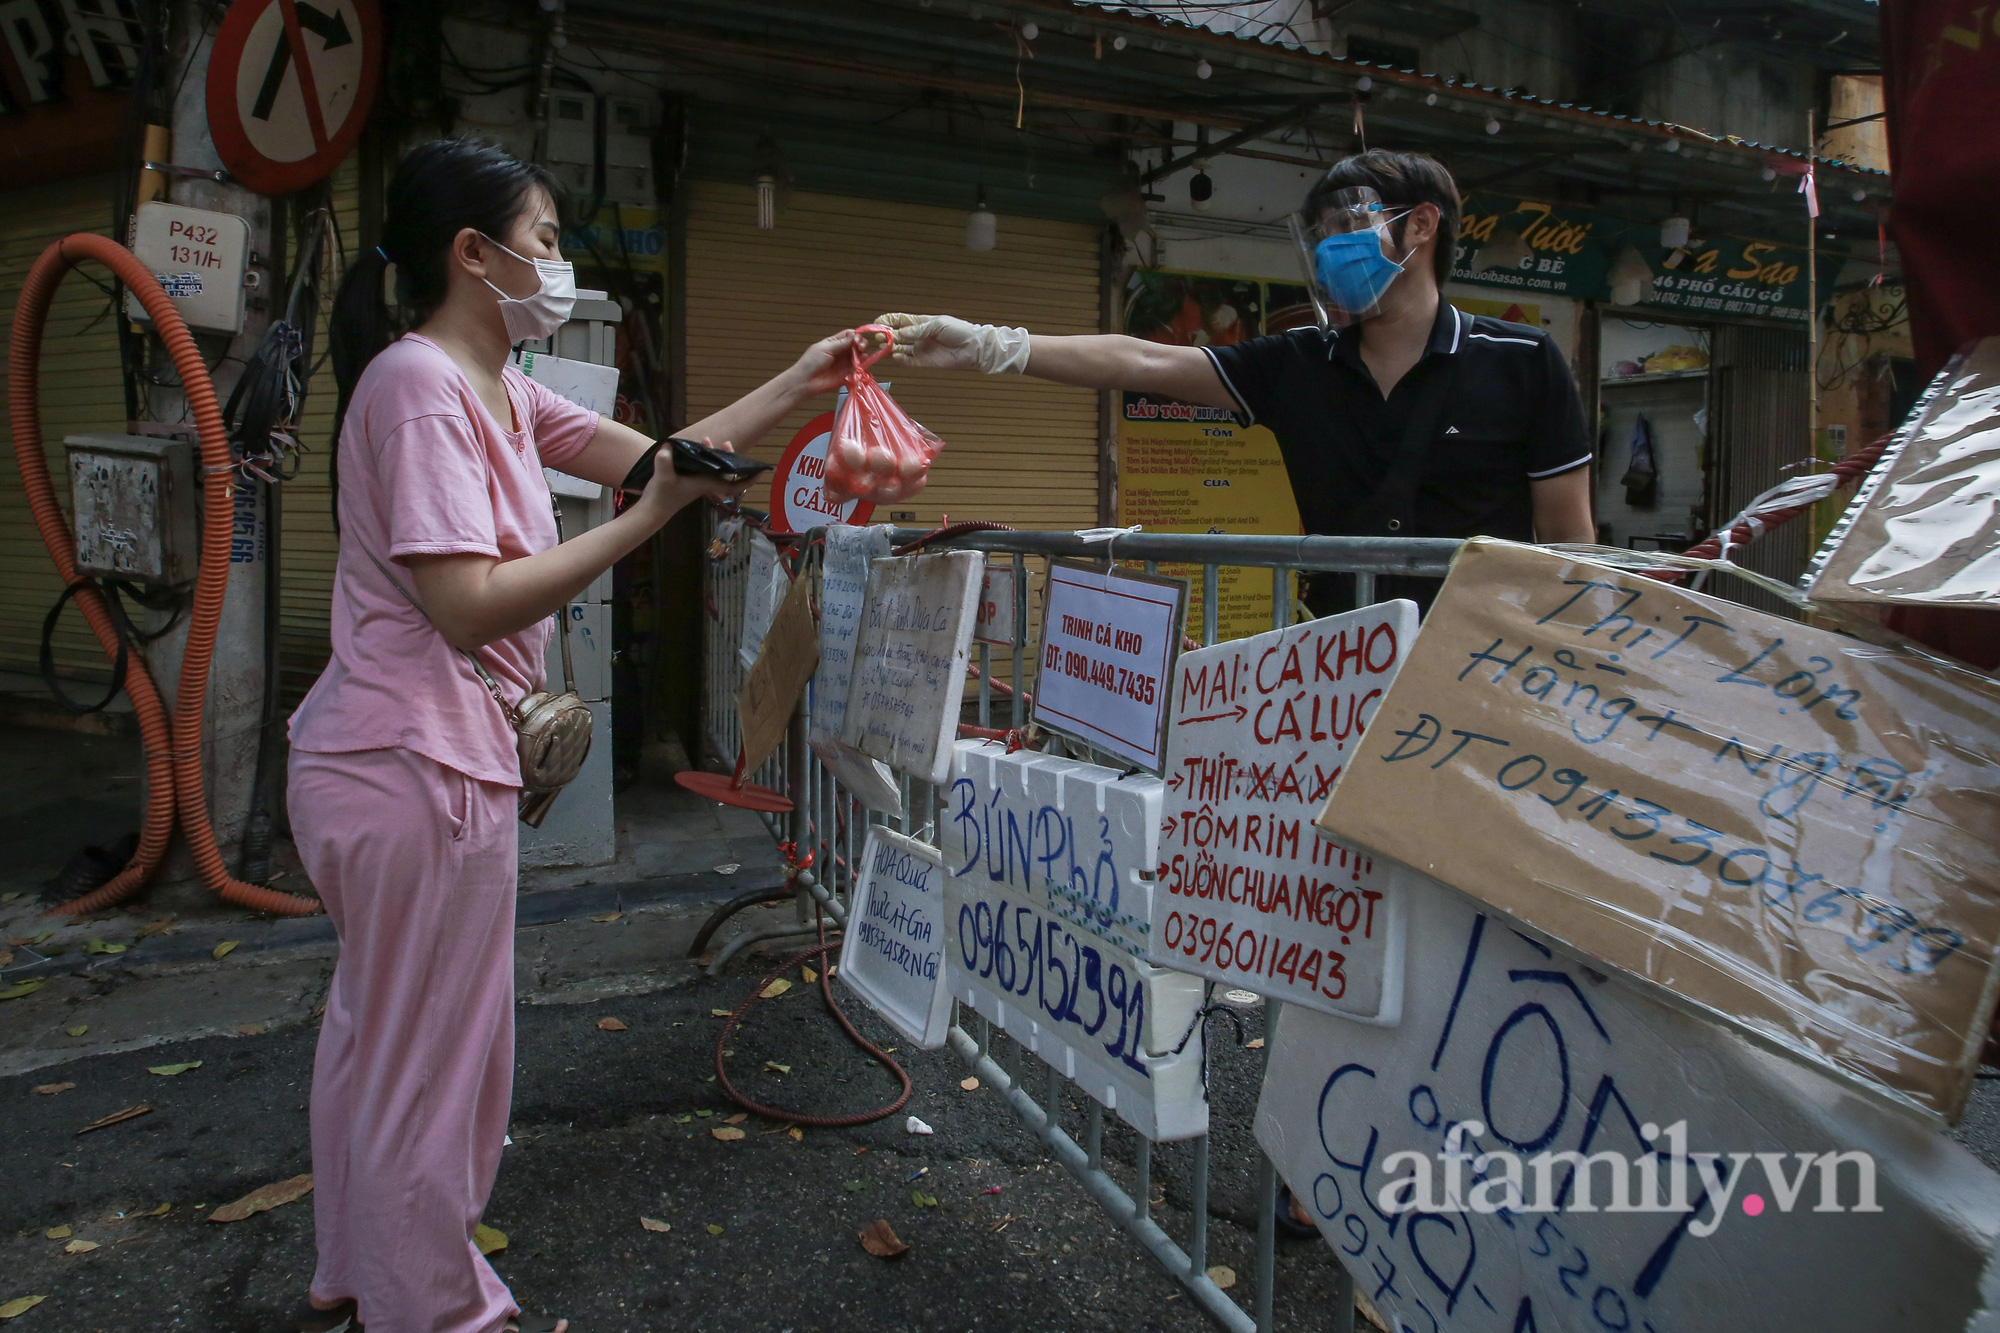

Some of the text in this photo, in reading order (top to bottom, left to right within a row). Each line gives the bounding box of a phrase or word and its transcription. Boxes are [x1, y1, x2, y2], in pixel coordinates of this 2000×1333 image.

[169, 220, 218, 245] P432
[1453, 194, 1593, 255] oa Tươi
[170, 245, 222, 270] 131/H
[1726, 242, 1799, 285] Sao
[1652, 275, 1785, 302] 46 PHỐ CẦU GỖ
[1202, 427, 1233, 438] TÔM
[1225, 439, 1246, 449] Shrimp
[796, 454, 826, 480] KHU
[1203, 479, 1231, 487] CUA
[1238, 467, 1258, 476] Shrimp
[1125, 489, 1136, 497] Cua
[1176, 489, 1189, 497] Crab
[1125, 508, 1136, 516] Cua
[1177, 508, 1191, 516] Crab
[1062, 614, 1143, 656] TRINH CÁ KHO
[1065, 651, 1156, 706] 090.449.7435
[1180, 622, 1398, 714] MAI: CÁ KHO
[1253, 690, 1307, 745] CÁ
[1380, 712, 1511, 770] ĐT
[951, 777, 1034, 894] BÚN
[1180, 803, 1239, 849] TÔM
[871, 841, 897, 877] HOA
[1228, 865, 1298, 917] CHUA
[1295, 875, 1384, 945] NGỌT
[1164, 911, 1348, 1000] 0396011443
